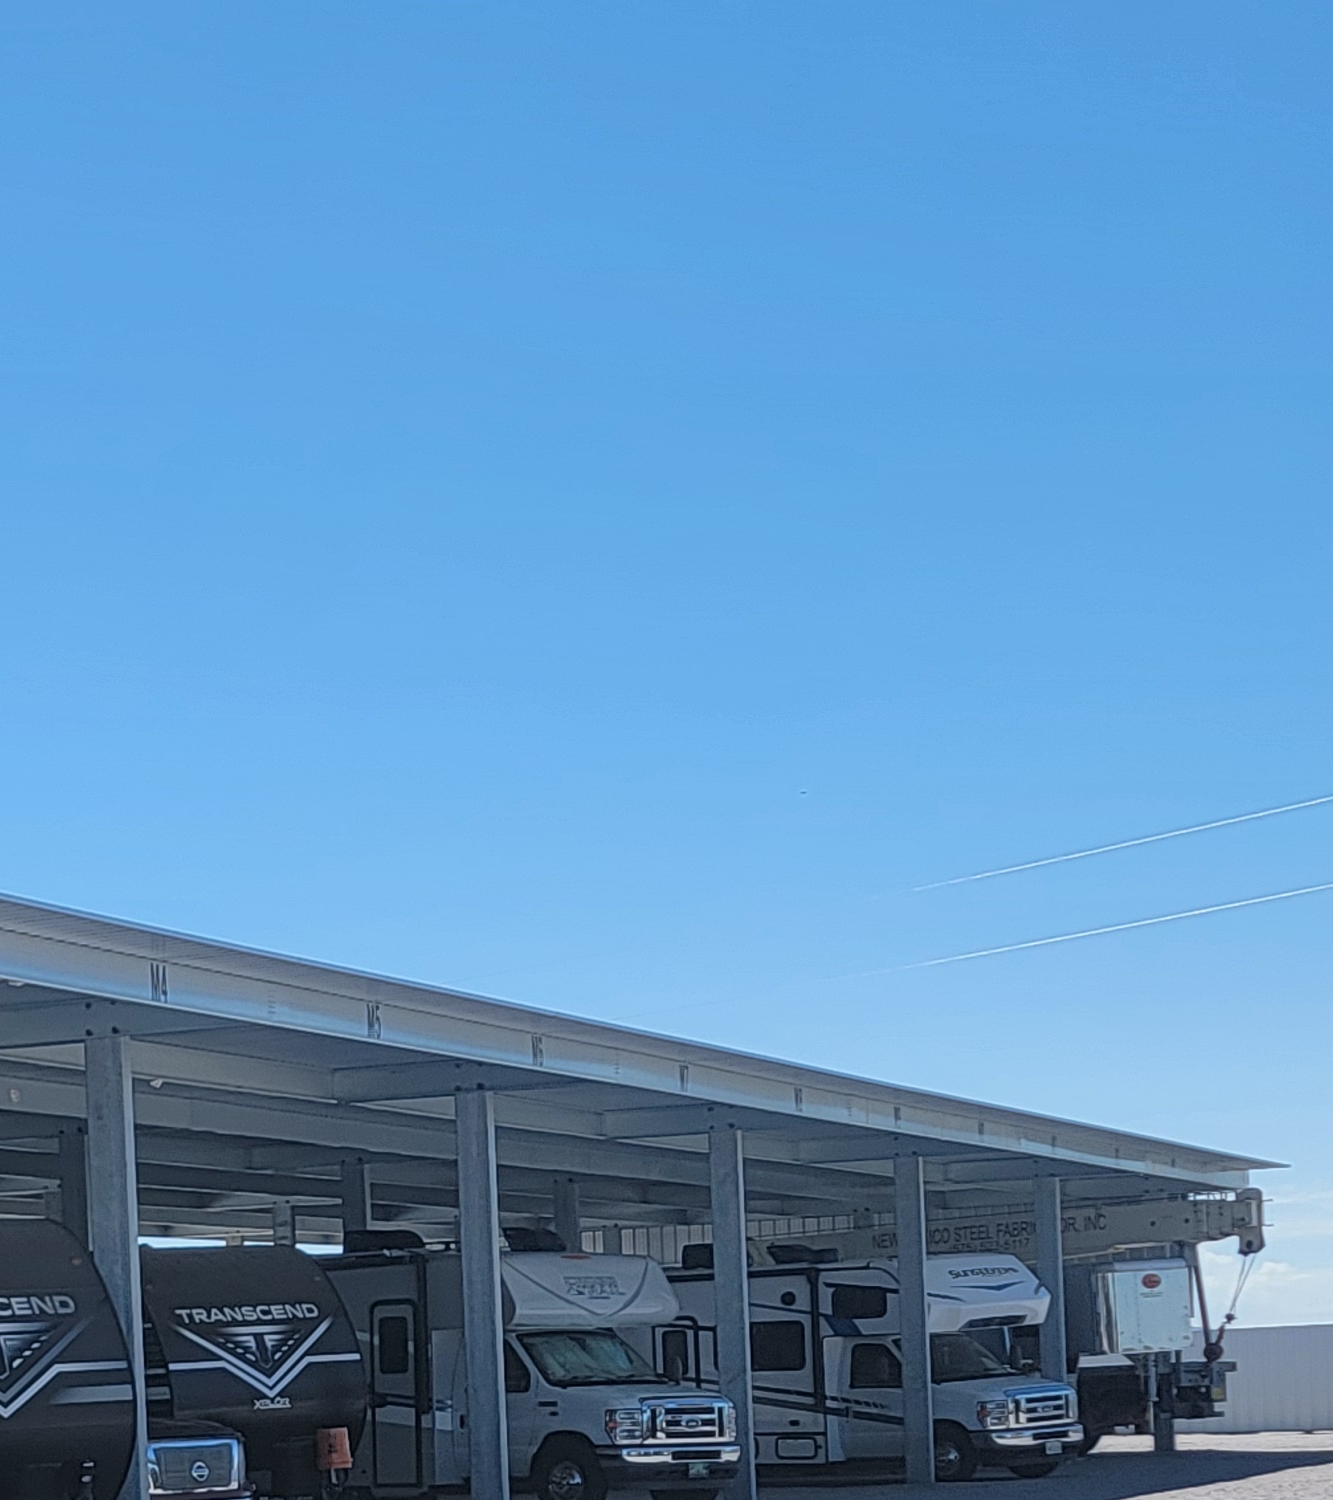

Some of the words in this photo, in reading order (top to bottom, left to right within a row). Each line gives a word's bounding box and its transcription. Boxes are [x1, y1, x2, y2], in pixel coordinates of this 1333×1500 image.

[150, 961, 168, 1004] M4
[366, 1003, 382, 1039] M5
[953, 1225, 994, 1242] STEEL
[1084, 1213, 1107, 1232] INC
[173, 1302, 320, 1324] TRANSCEND
